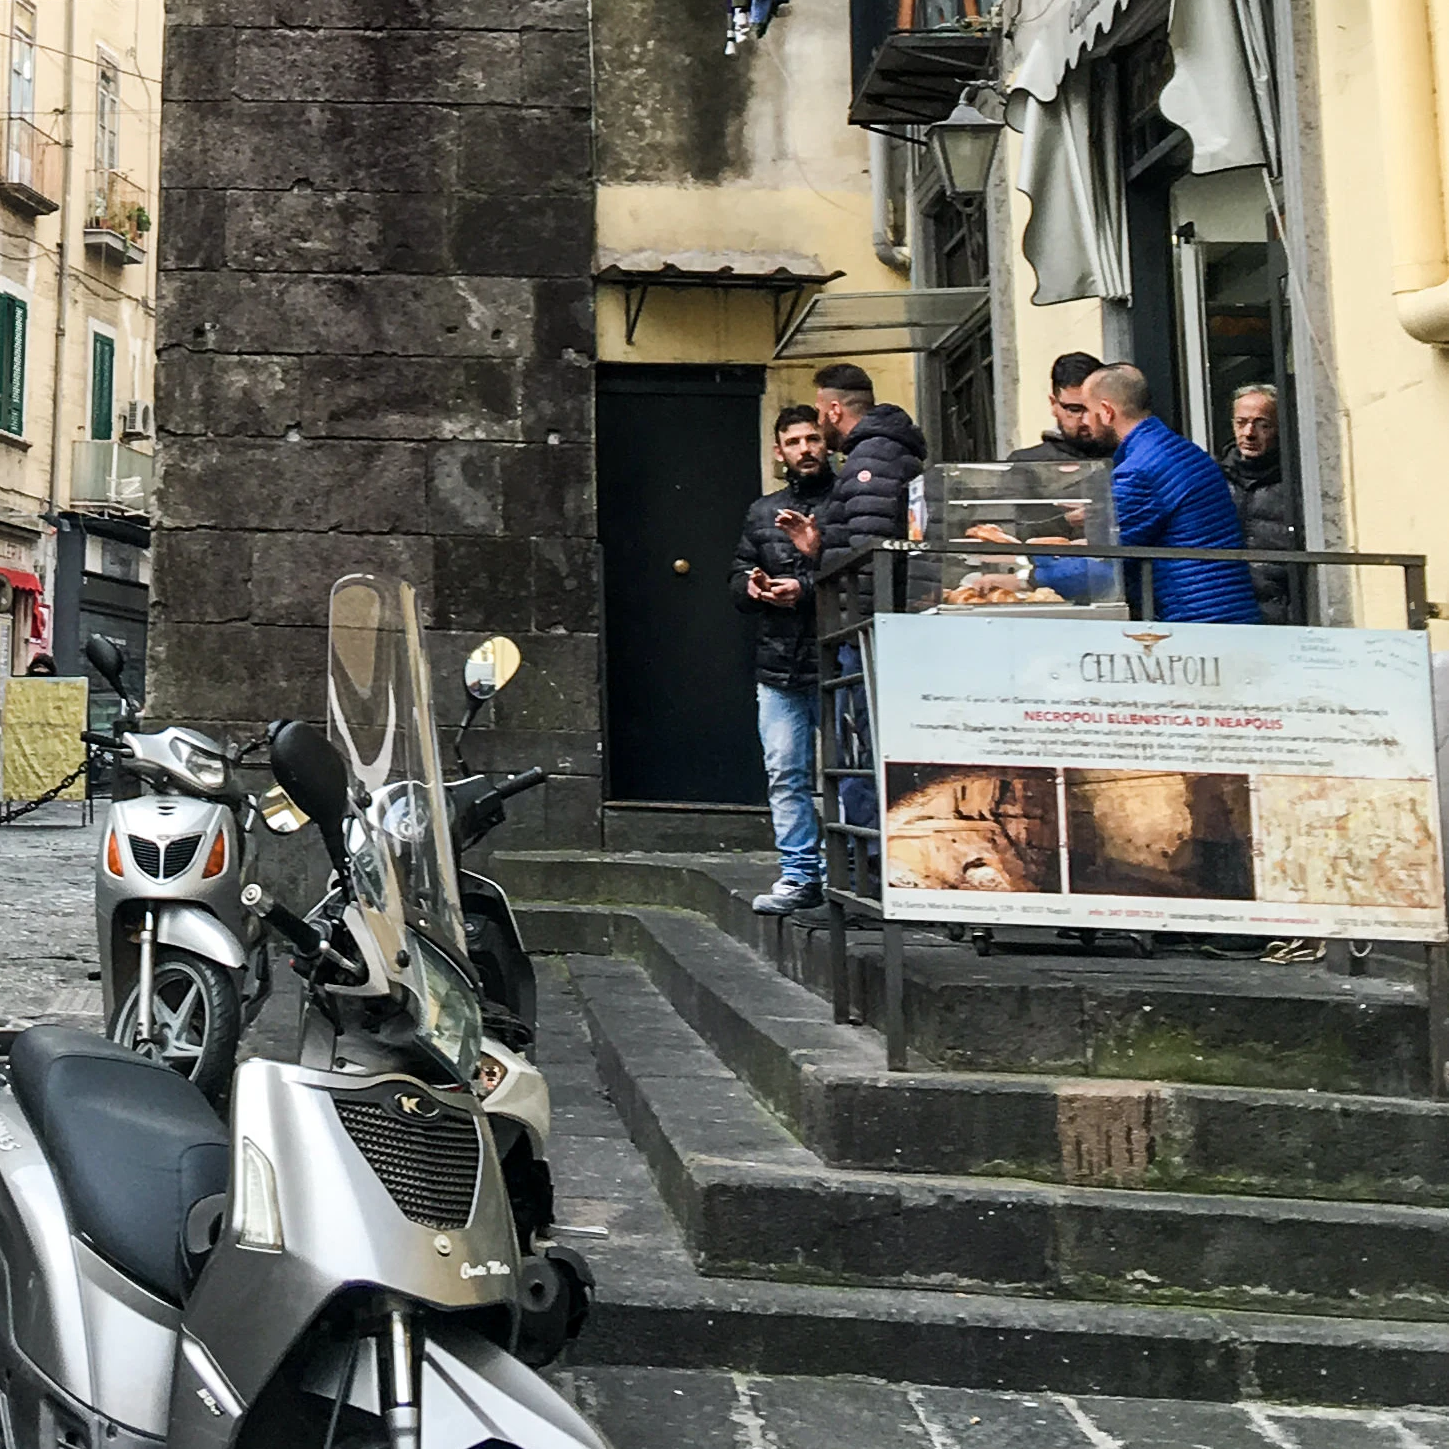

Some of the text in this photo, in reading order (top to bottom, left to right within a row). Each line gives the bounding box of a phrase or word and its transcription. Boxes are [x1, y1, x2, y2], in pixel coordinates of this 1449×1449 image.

[1079, 652, 1221, 687] CELANAPOLI
[1024, 710, 1283, 731] NECROPOLI ELLENISTICA DI NEAPOLIS
